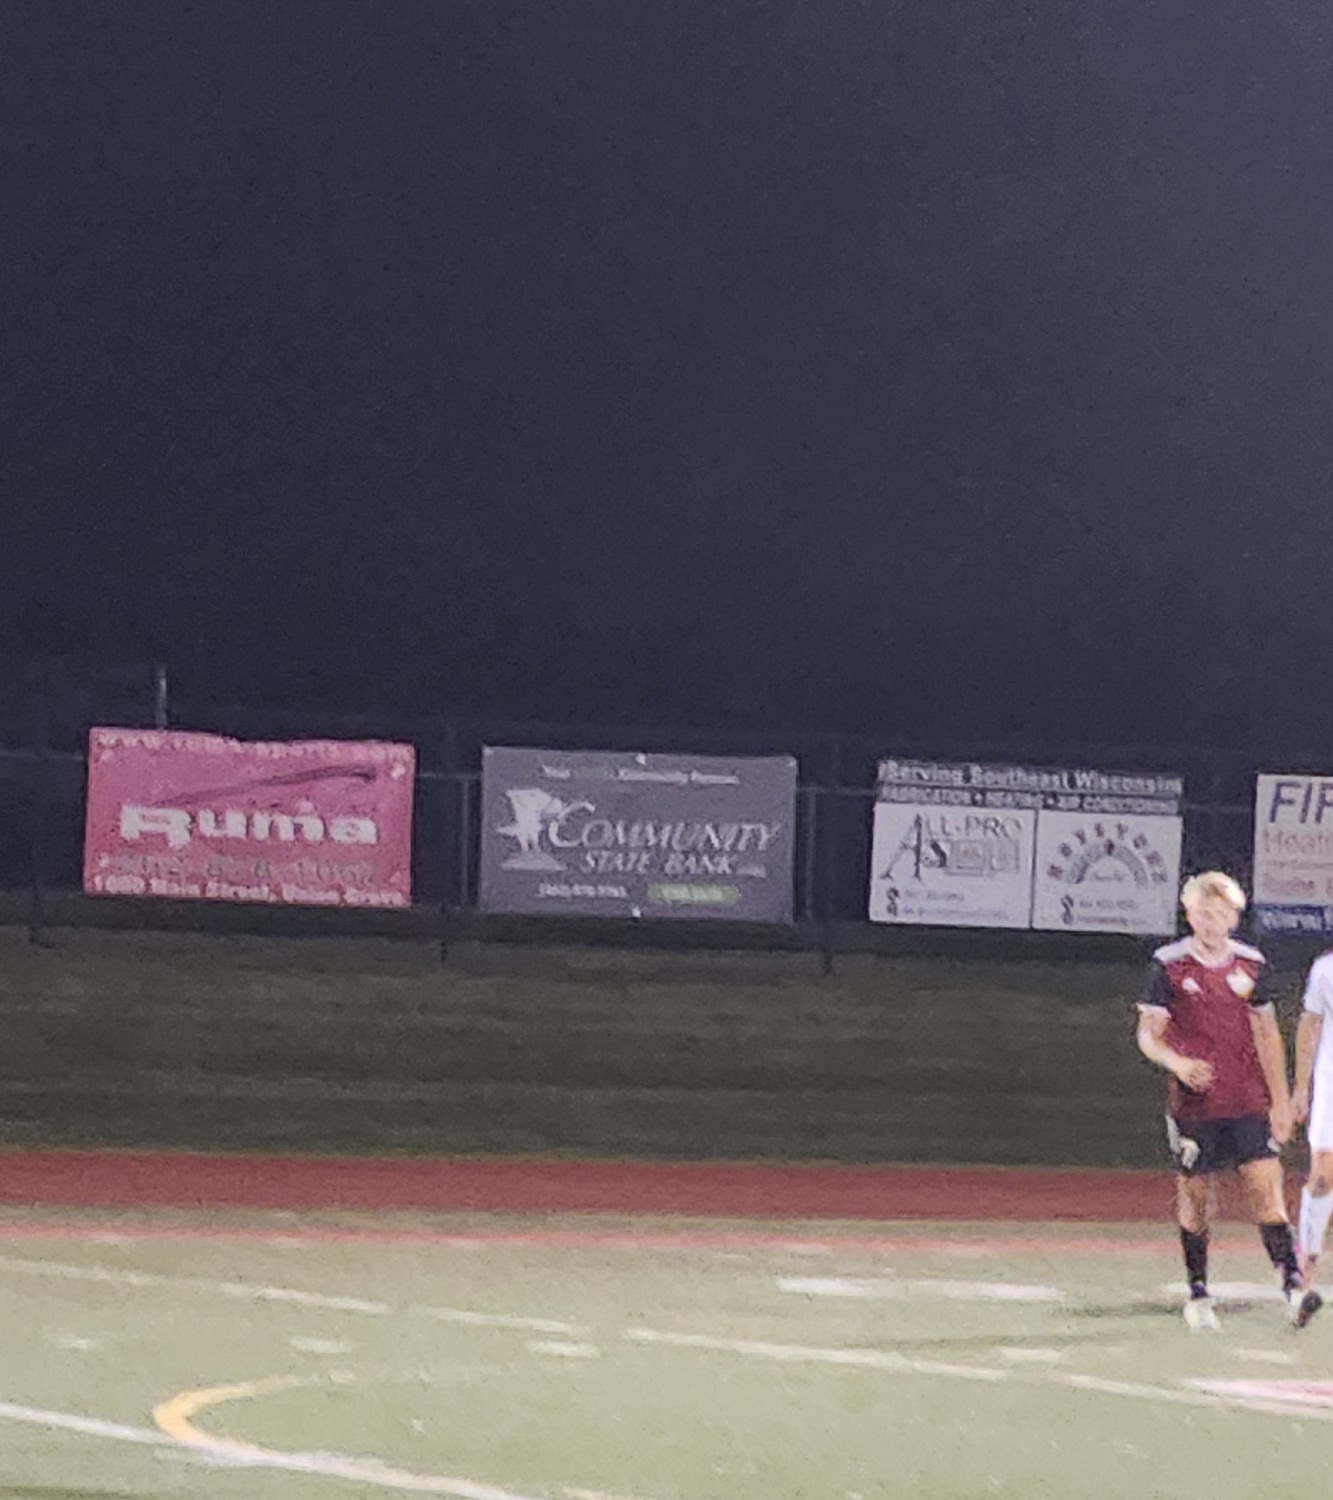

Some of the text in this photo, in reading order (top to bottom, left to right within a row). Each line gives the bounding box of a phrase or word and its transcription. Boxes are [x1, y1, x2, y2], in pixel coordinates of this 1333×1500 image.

[884, 760, 1184, 796] Serving Southeast Wisconsin
[119, 803, 378, 848] Ruma
[547, 800, 779, 850] COMMUNITY
[580, 851, 651, 875] STATE
[664, 853, 738, 877] BANK
